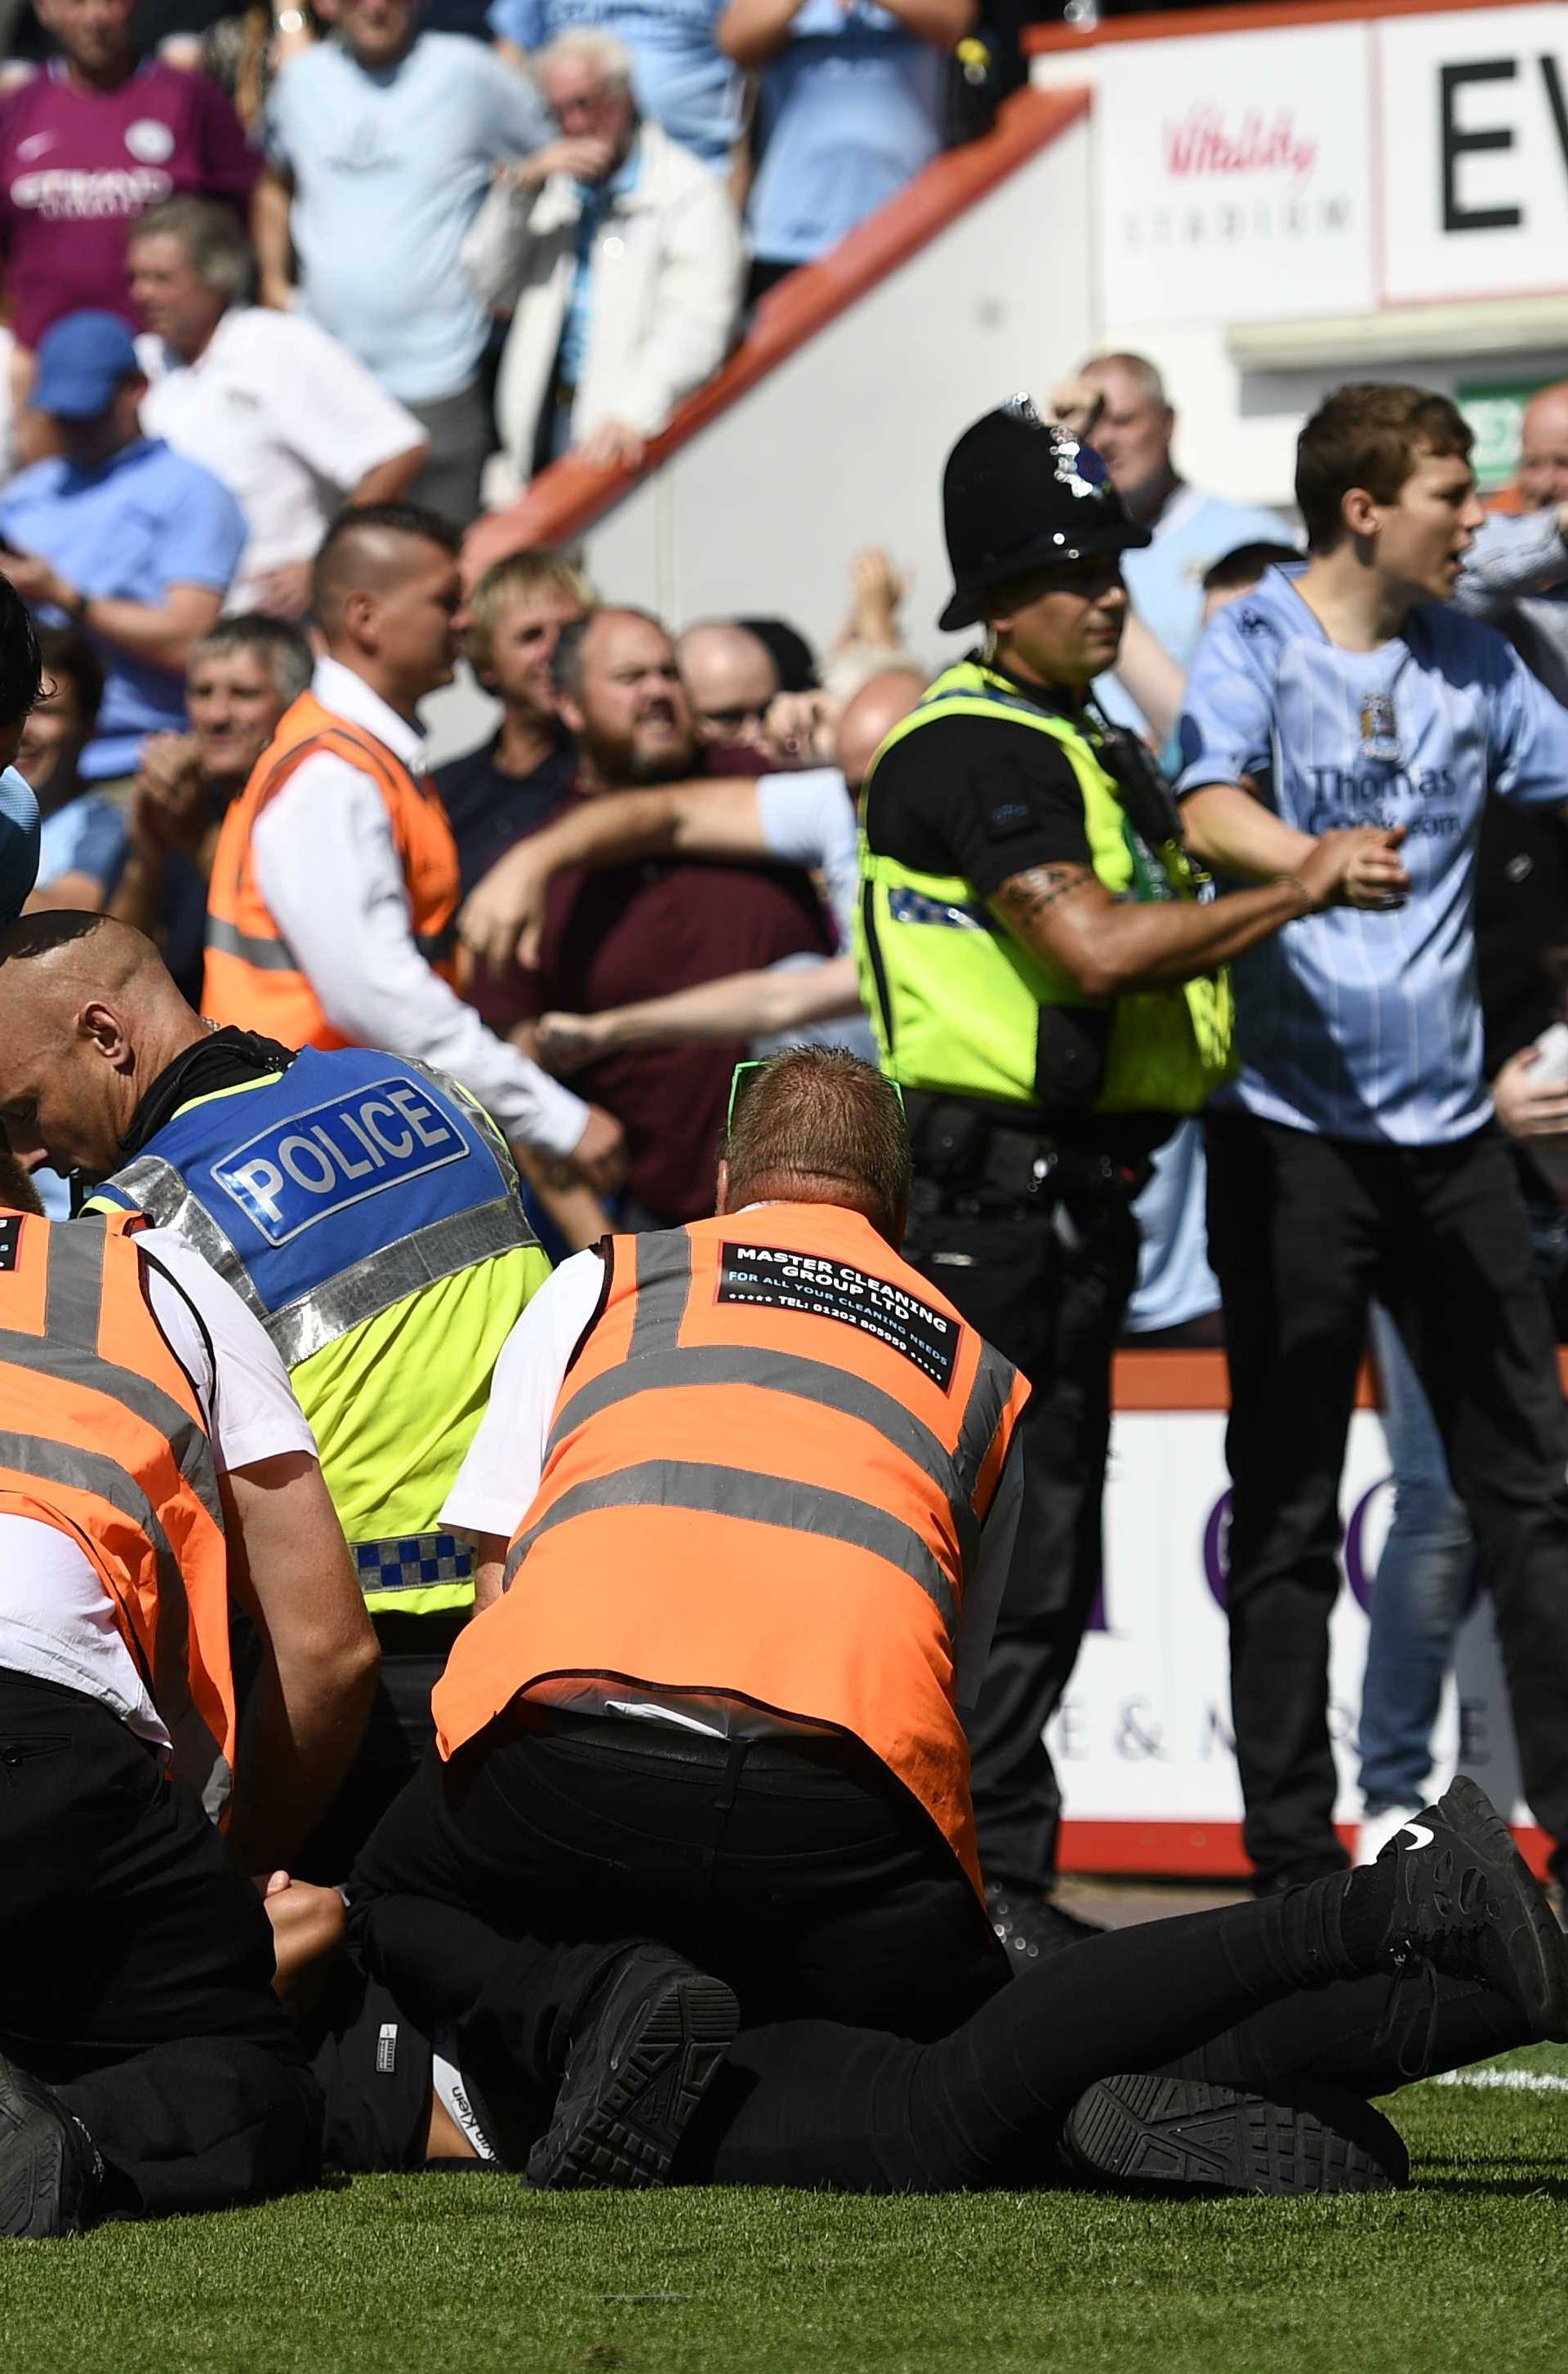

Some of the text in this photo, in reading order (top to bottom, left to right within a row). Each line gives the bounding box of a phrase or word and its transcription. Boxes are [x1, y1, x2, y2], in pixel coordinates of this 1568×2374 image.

[1307, 764, 1457, 803] Thomas
[233, 1089, 450, 1222] POLICE
[737, 1248, 947, 1333] MASTER CLEANING
[778, 1295, 808, 1310] TEL:
[813, 1303, 858, 1324] 01202
[782, 1267, 909, 1320] GROUP LTD
[728, 1271, 948, 1366] FOR ALL YOUR CLEANING NEEDS
[451, 2086, 477, 2130] Klein
